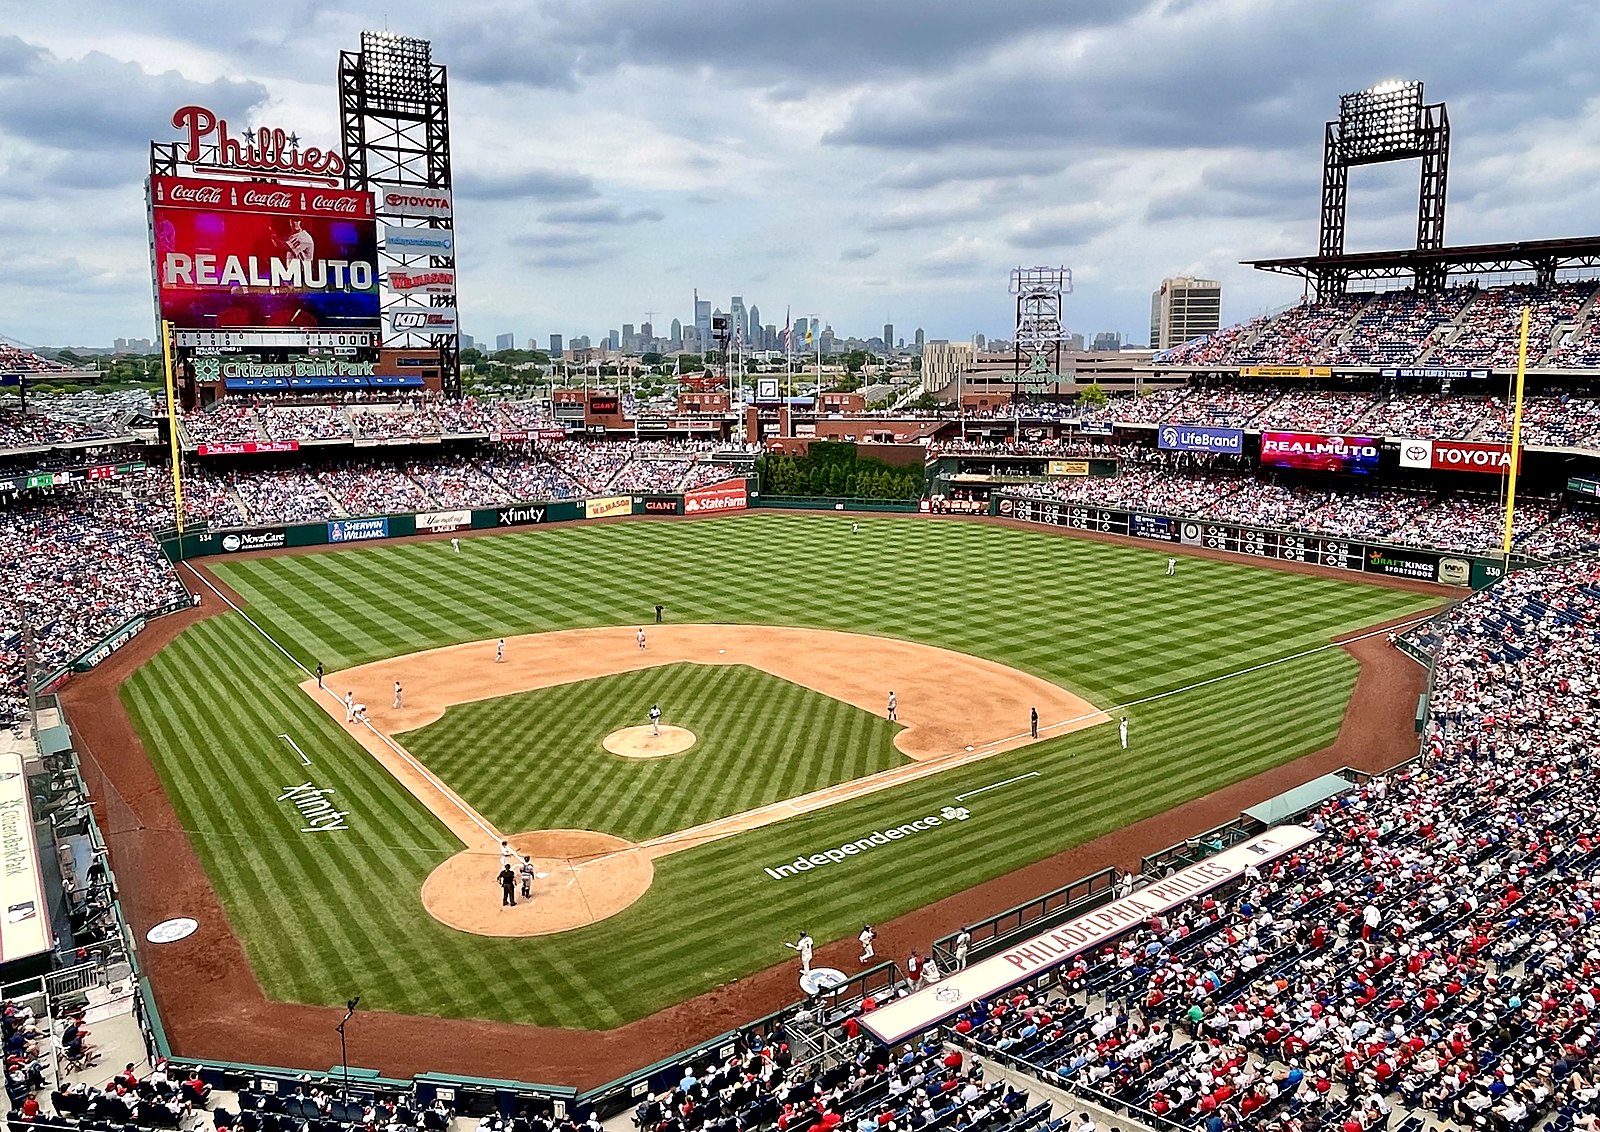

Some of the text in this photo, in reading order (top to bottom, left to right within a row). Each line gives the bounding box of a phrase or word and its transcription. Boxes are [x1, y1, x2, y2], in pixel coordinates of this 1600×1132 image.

[171, 105, 345, 175] Phillies
[170, 184, 224, 204] Coca-Cola
[243, 189, 294, 209] Coca-Cola
[401, 196, 450, 209] TOYOTA
[312, 194, 360, 213] Coca-Cola
[165, 252, 373, 290] REALMUTO
[394, 313, 427, 328] KDI
[223, 360, 375, 378] Citizens Bank Park
[502, 433, 528, 441] TOYOTA
[539, 431, 564, 439] TOYOTA
[1180, 432, 1239, 449] LifeBrand
[1263, 439, 1378, 458] REALMUTO
[1435, 448, 1513, 467] TOYOTA
[645, 502, 677, 510] GIANT
[499, 506, 545, 525] xfinity
[344, 520, 382, 531] SHERWIN
[241, 532, 285, 544] NovaCare
[1384, 565, 1433, 578] SPORTSBOOK
[1485, 566, 1501, 577] 330
[277, 781, 351, 832] xfinity
[763, 814, 943, 880] Independence
[1003, 861, 1232, 971] PHILADELPHIA PHILLIES
